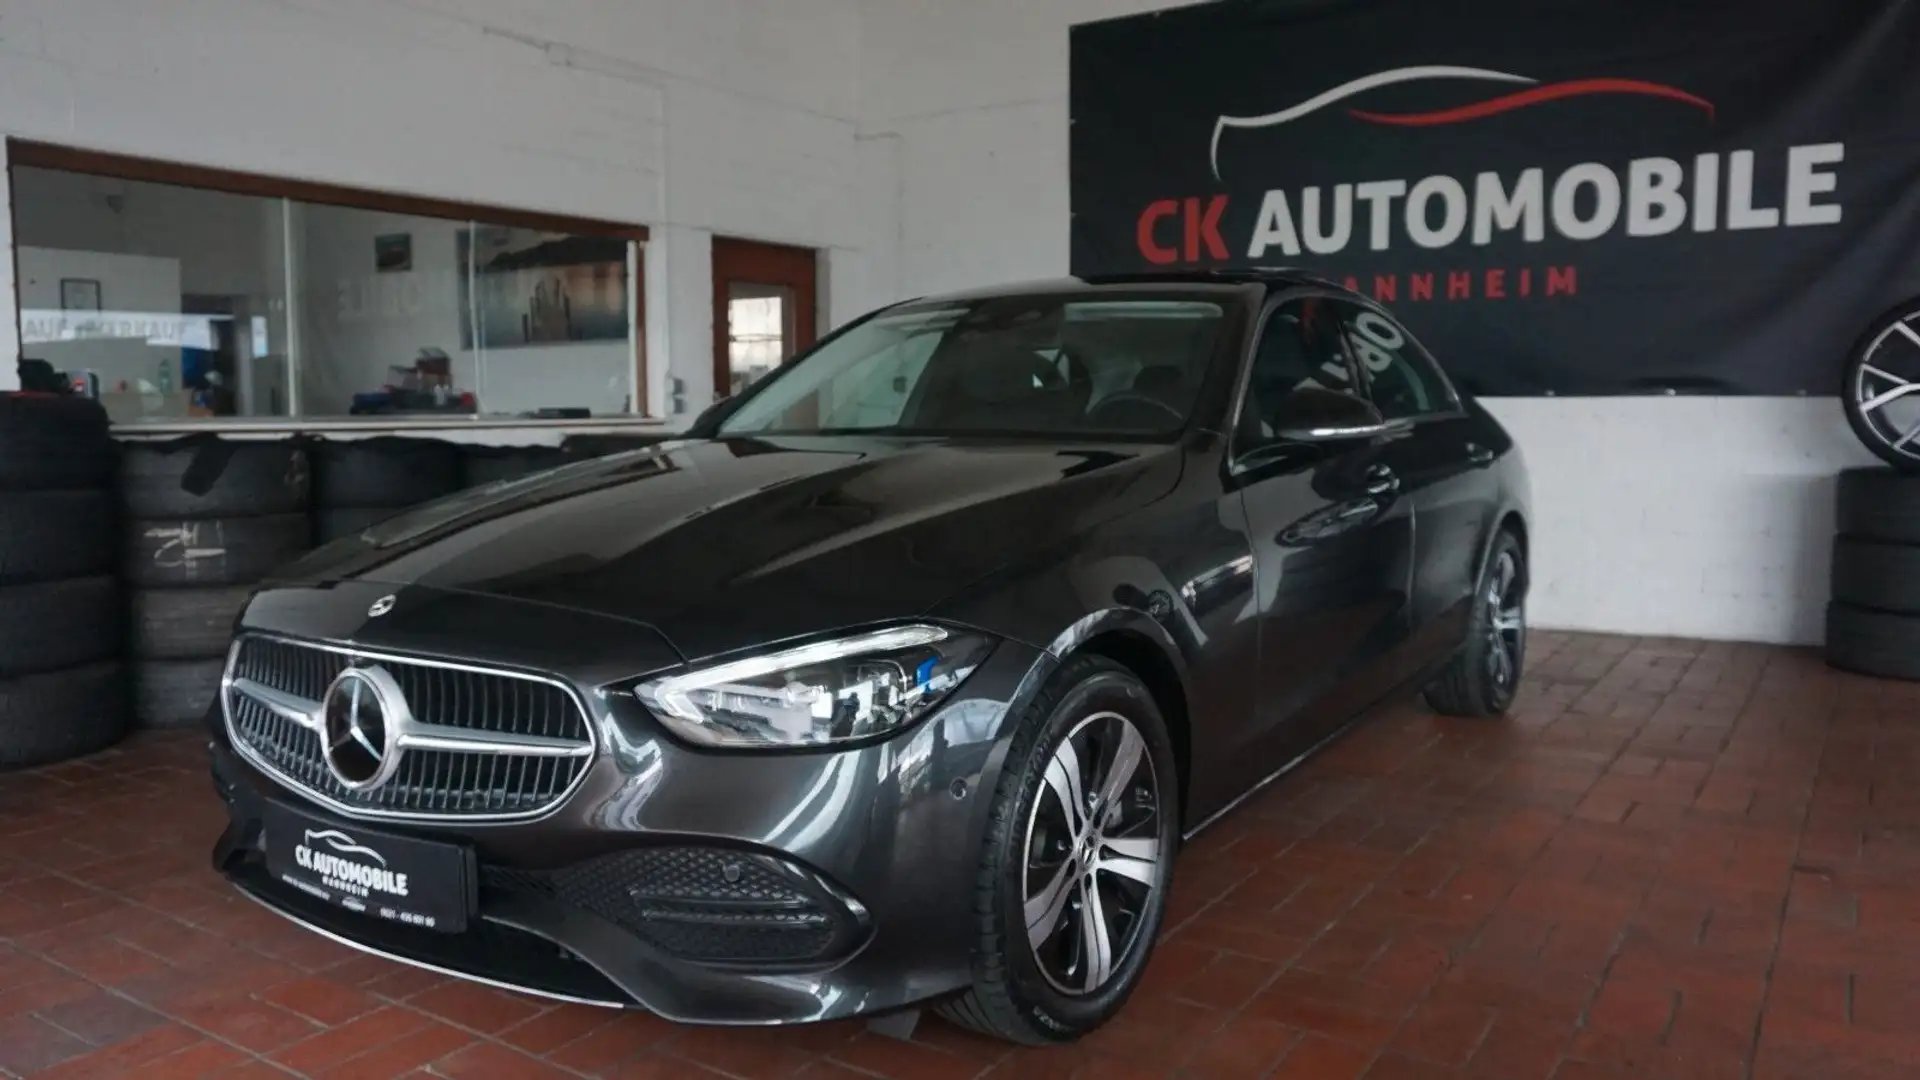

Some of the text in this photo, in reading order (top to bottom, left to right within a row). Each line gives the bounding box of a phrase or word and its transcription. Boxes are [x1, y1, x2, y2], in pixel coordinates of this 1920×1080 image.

[1136, 142, 1845, 264] CK AUTOMOBILE
[1343, 264, 1578, 303] ANNHEIM
[295, 844, 313, 870] CK
[313, 851, 409, 897] AUTOMOBILE
